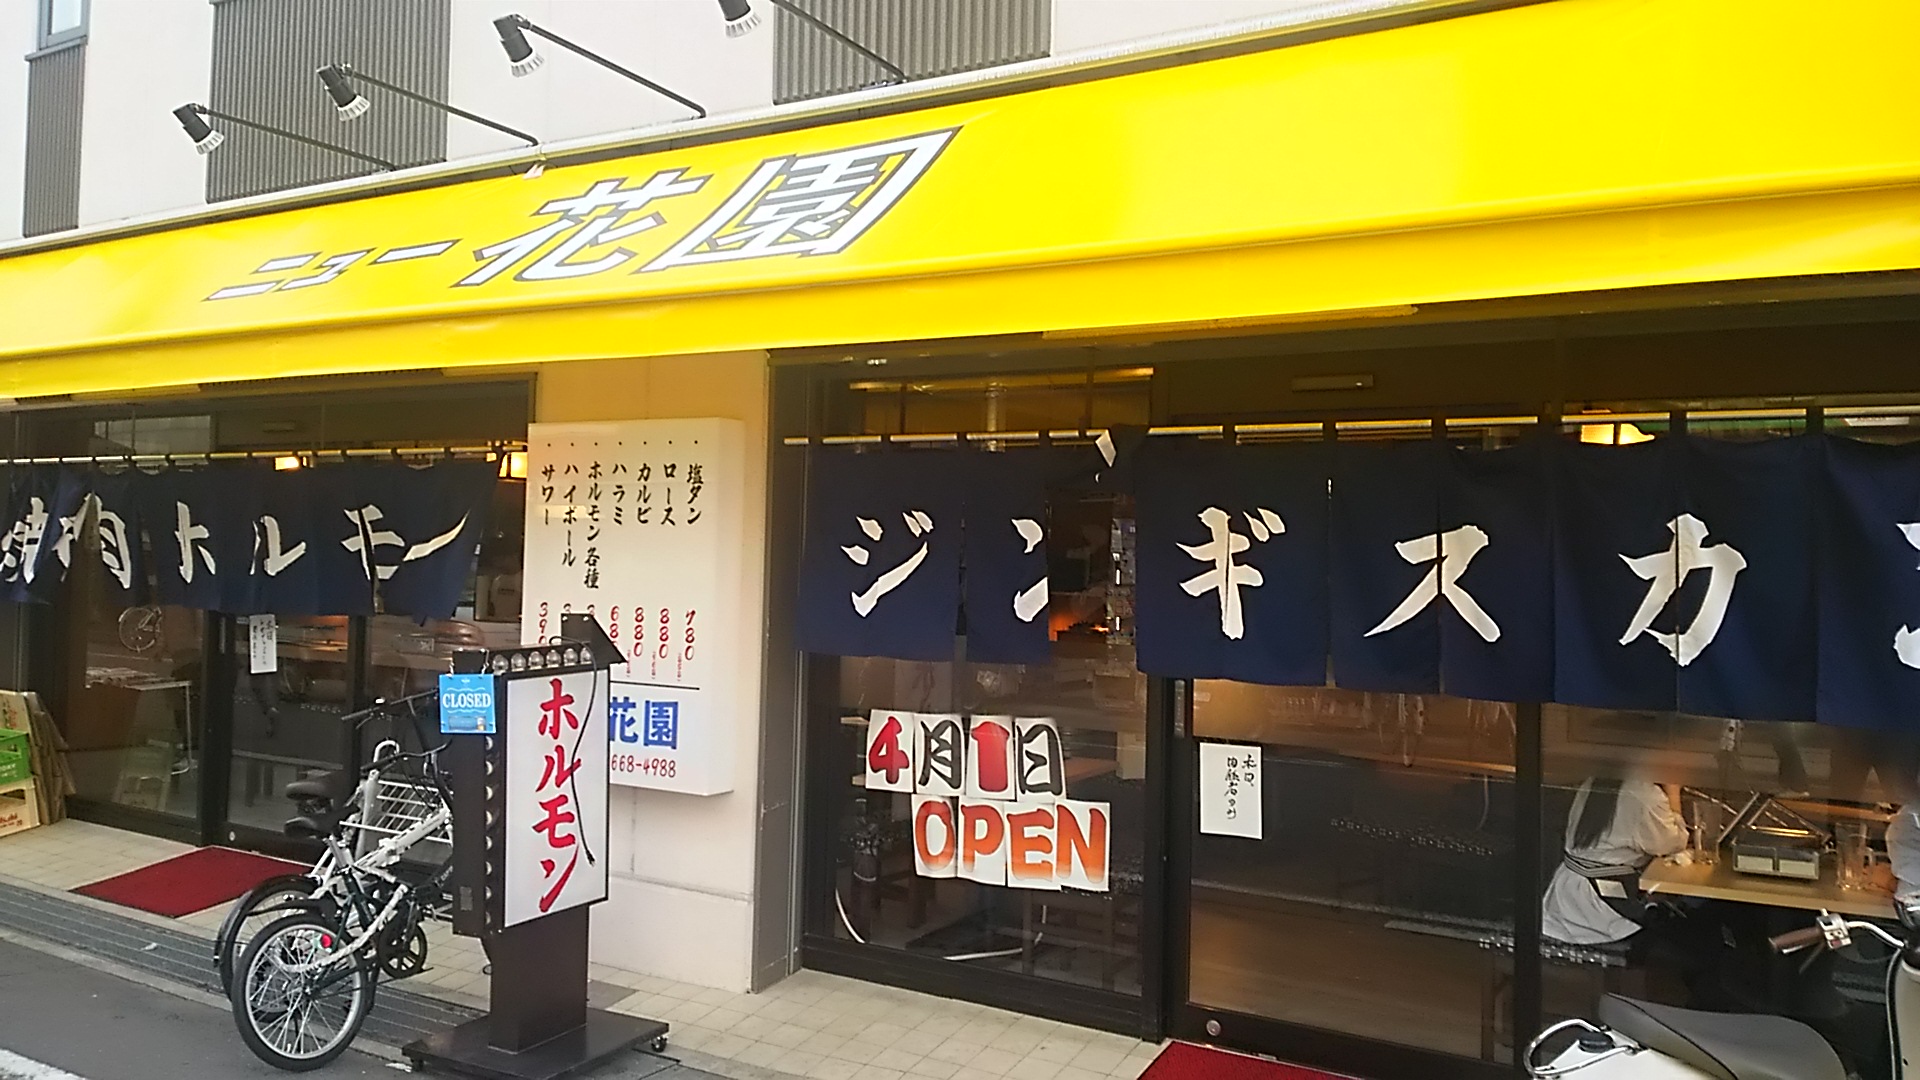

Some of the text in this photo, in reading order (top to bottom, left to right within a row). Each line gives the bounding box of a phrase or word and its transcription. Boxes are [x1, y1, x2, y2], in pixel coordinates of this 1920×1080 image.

[203, 125, 962, 301] ニュー花園
[541, 464, 555, 525] サワー
[562, 464, 579, 567] ハイボール
[584, 461, 603, 589] ホルモン各種
[609, 464, 627, 647] ハラミ 68
[633, 463, 651, 656] カルビ 880
[659, 463, 677, 658] ロース 880
[685, 463, 704, 660] 塩タン 780
[442, 693, 491, 708] CLOSED
[610, 696, 679, 749] 花園
[869, 716, 1064, 795] 4月1日
[532, 678, 581, 913] ホルモン
[915, 800, 1107, 884] OPEN
